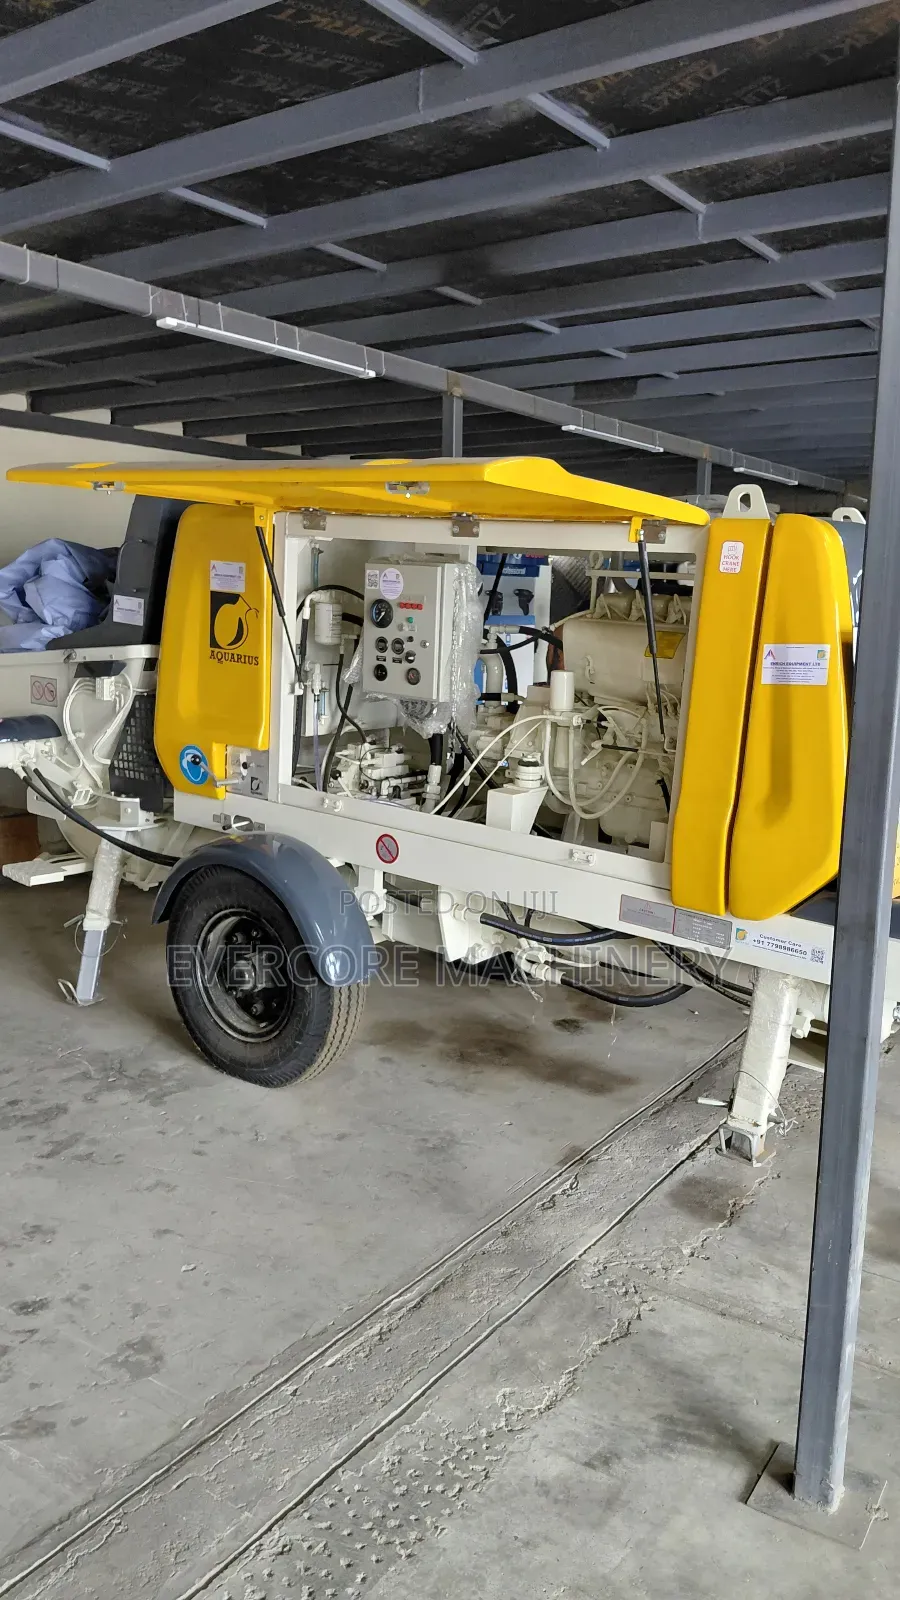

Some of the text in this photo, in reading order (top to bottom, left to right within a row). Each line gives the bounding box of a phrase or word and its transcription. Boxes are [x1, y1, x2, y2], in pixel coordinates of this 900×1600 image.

[209, 650, 259, 666] AQUARIUS
[752, 938, 764, 946] +91
[759, 933, 787, 944] Customer
[788, 940, 802, 948] Care
